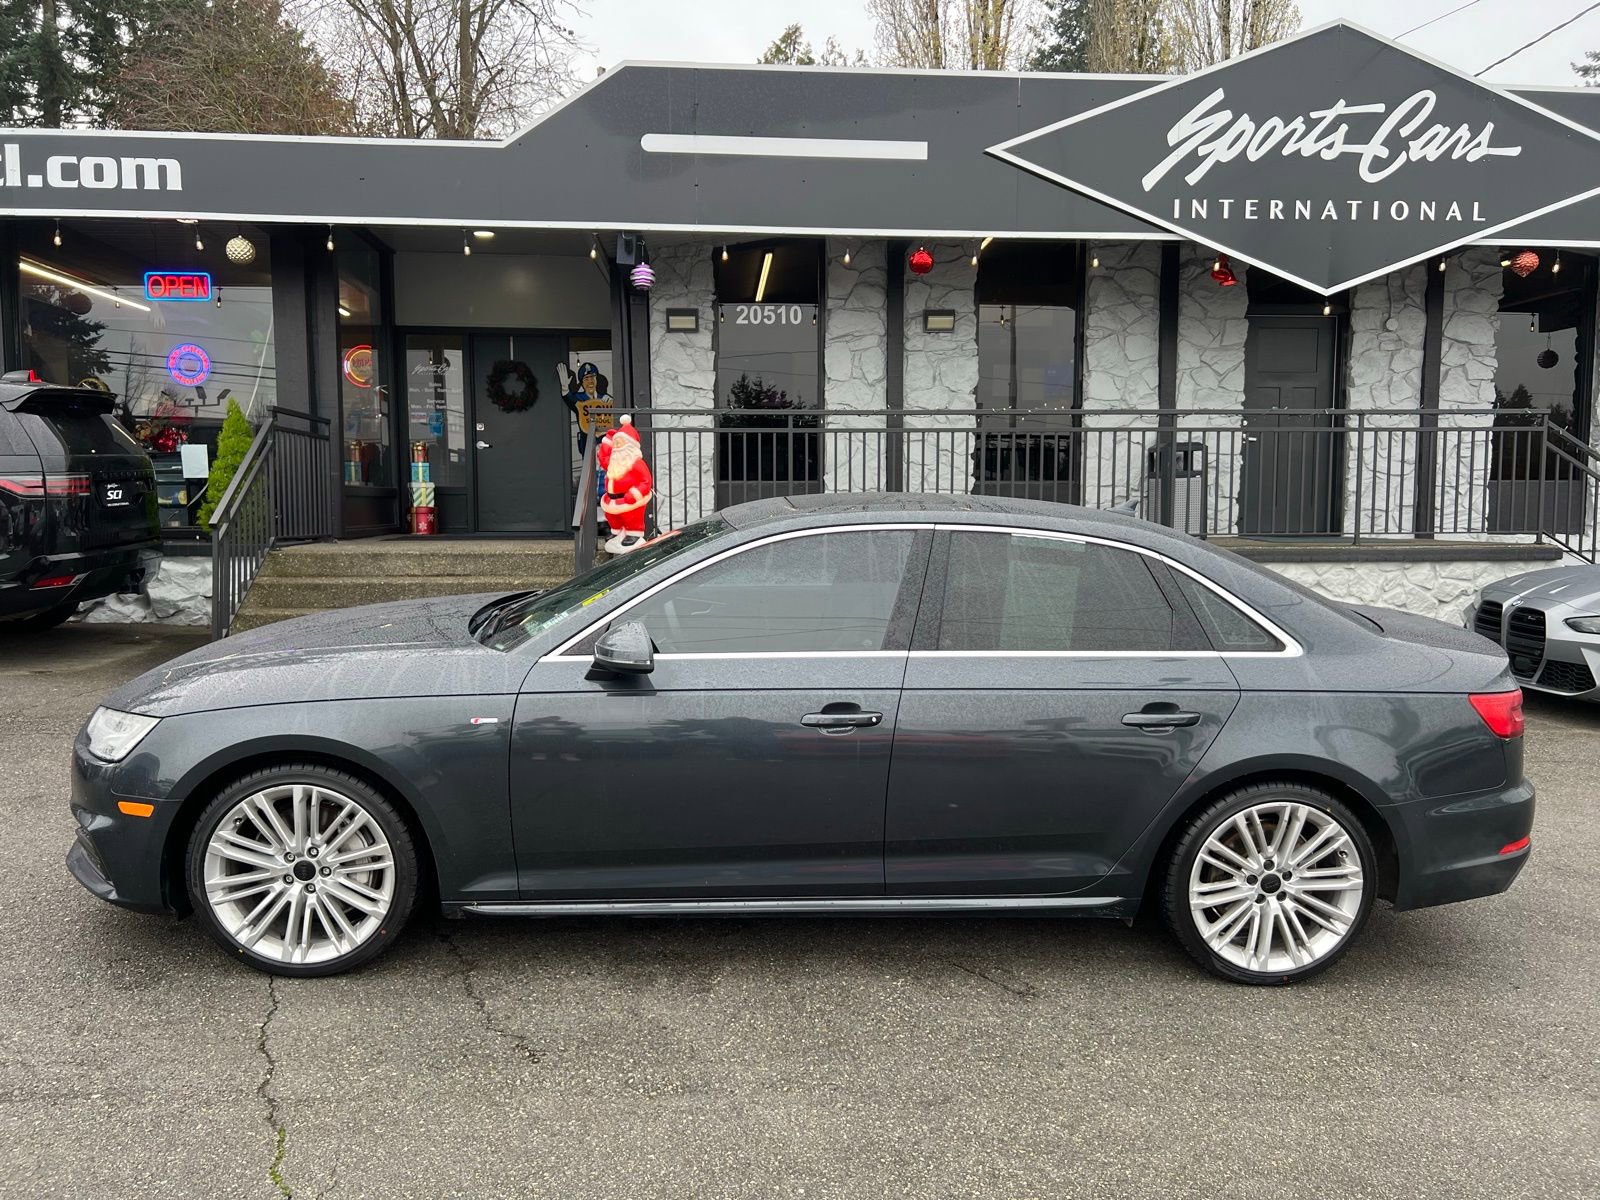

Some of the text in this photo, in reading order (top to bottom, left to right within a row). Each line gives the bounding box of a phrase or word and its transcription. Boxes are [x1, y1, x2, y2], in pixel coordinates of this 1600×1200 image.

[1141, 87, 1522, 192] Sports Cars
[0, 143, 183, 191] l.com
[1173, 198, 1487, 222] INTERNATIONAL
[148, 275, 209, 298] OPEN
[735, 305, 802, 325] 20510
[583, 405, 613, 416] SOW
